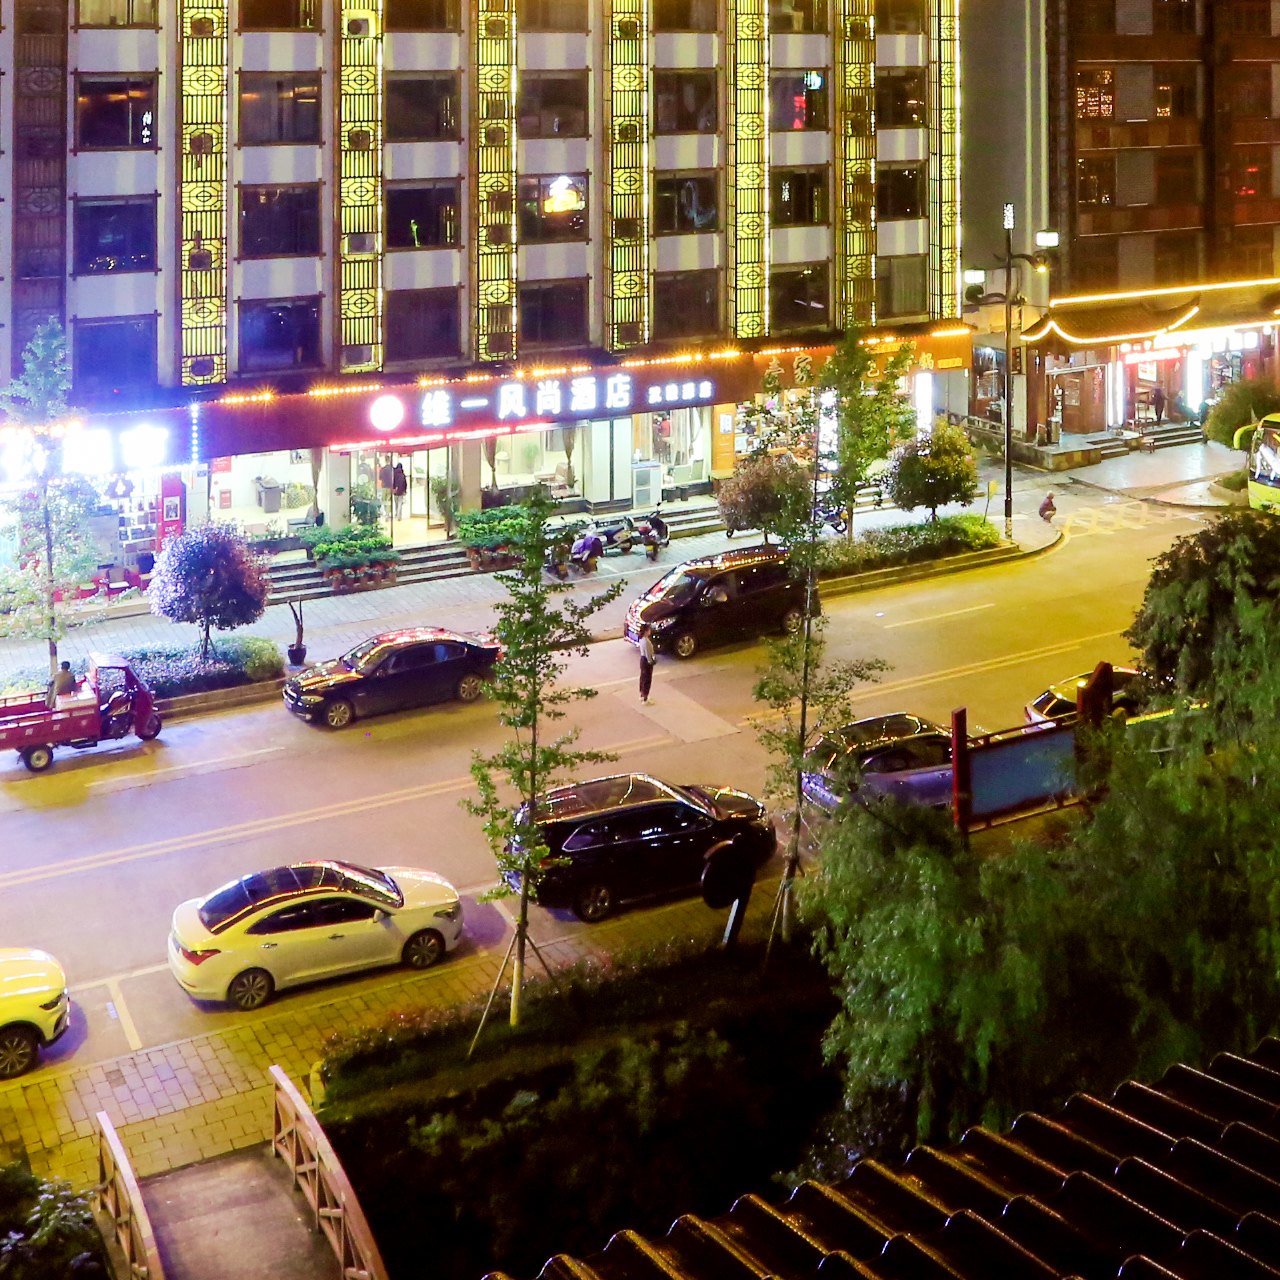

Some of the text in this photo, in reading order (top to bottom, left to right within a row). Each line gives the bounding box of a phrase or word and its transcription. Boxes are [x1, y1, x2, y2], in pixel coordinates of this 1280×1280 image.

[421, 374, 632, 426] 维一风尚酒店
